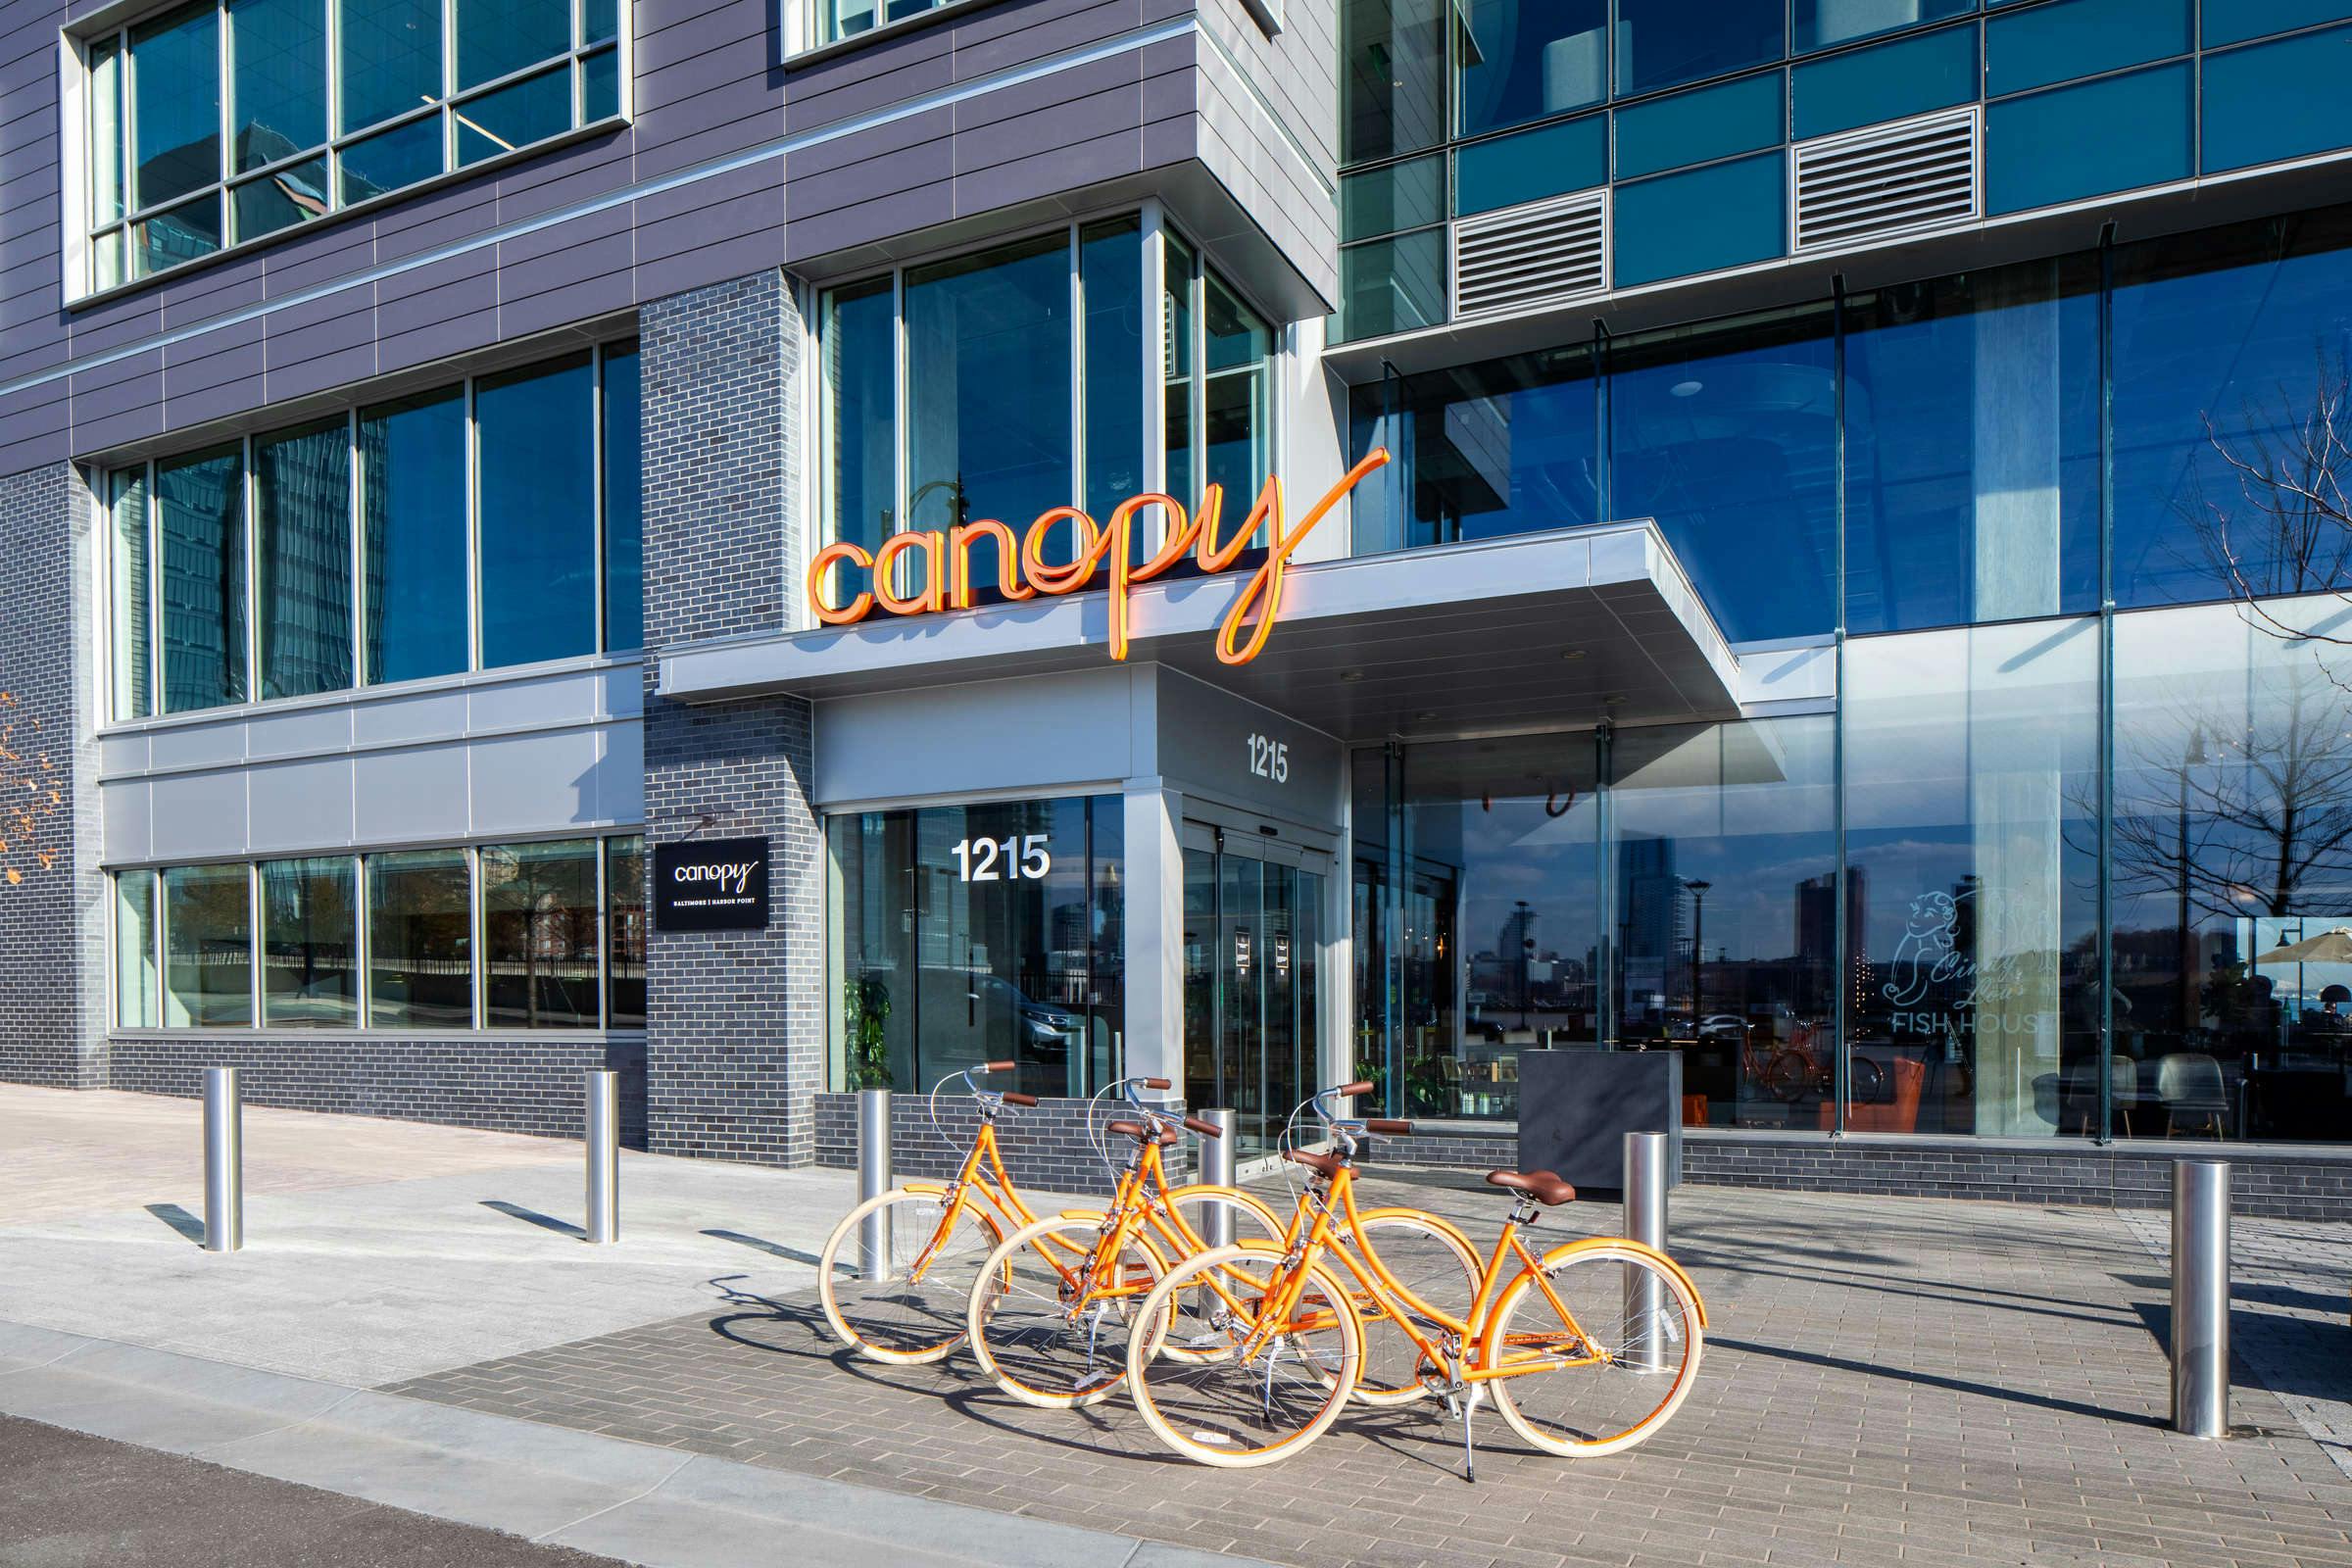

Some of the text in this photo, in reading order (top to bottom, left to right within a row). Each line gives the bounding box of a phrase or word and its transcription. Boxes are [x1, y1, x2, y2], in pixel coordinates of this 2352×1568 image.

[808, 447, 1391, 665] canopy
[1248, 733, 1288, 784] 1215
[674, 860, 759, 894] canopy
[952, 833, 1051, 882] 1215
[1892, 1012, 2057, 1034] FISH HOUSE
